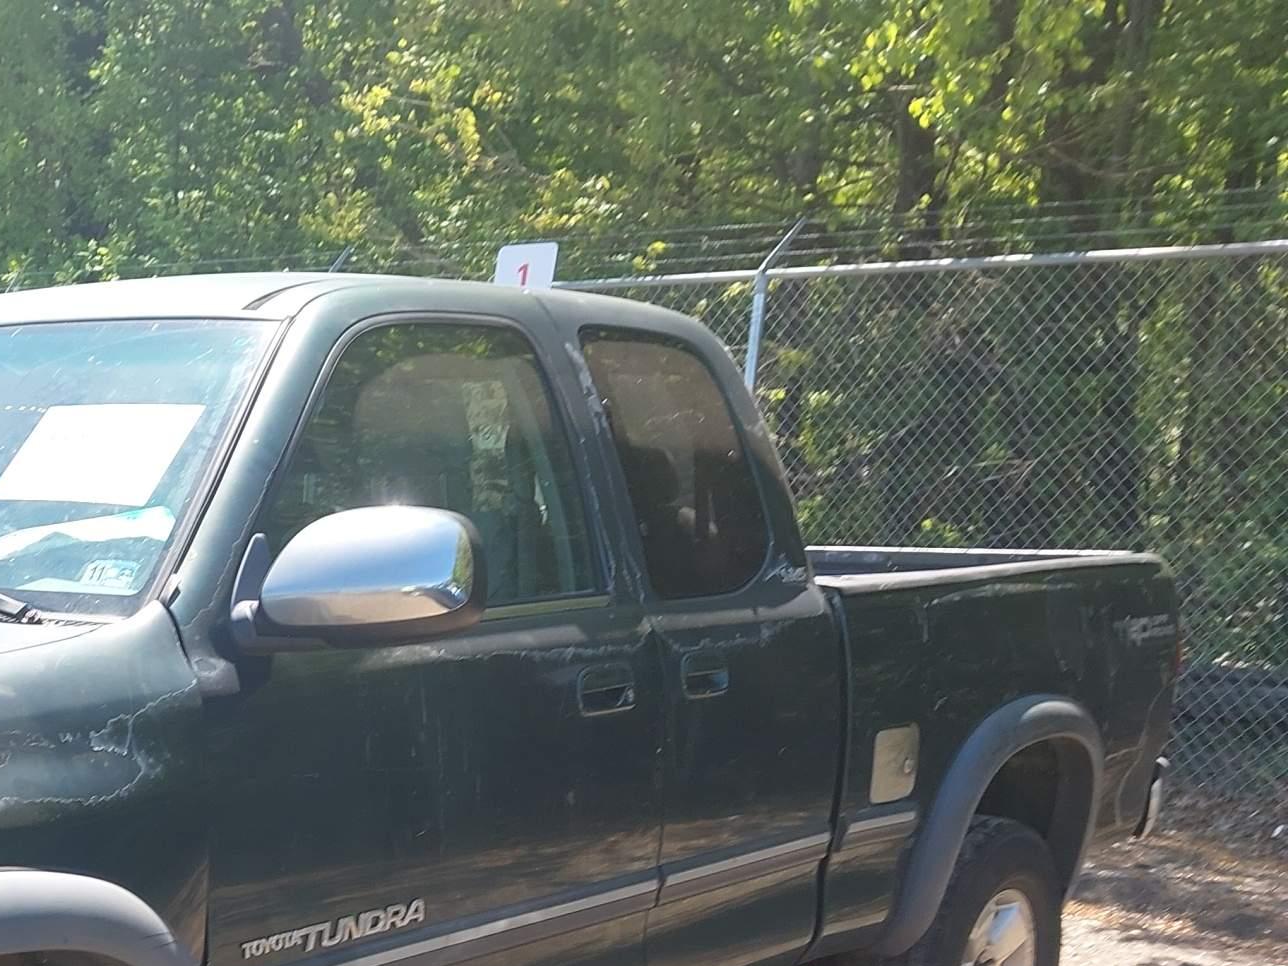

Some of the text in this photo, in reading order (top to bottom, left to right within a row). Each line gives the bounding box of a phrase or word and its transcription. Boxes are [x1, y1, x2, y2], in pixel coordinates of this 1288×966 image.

[517, 262, 529, 286] 1
[241, 898, 426, 960] TOYOTA TUNDRA
